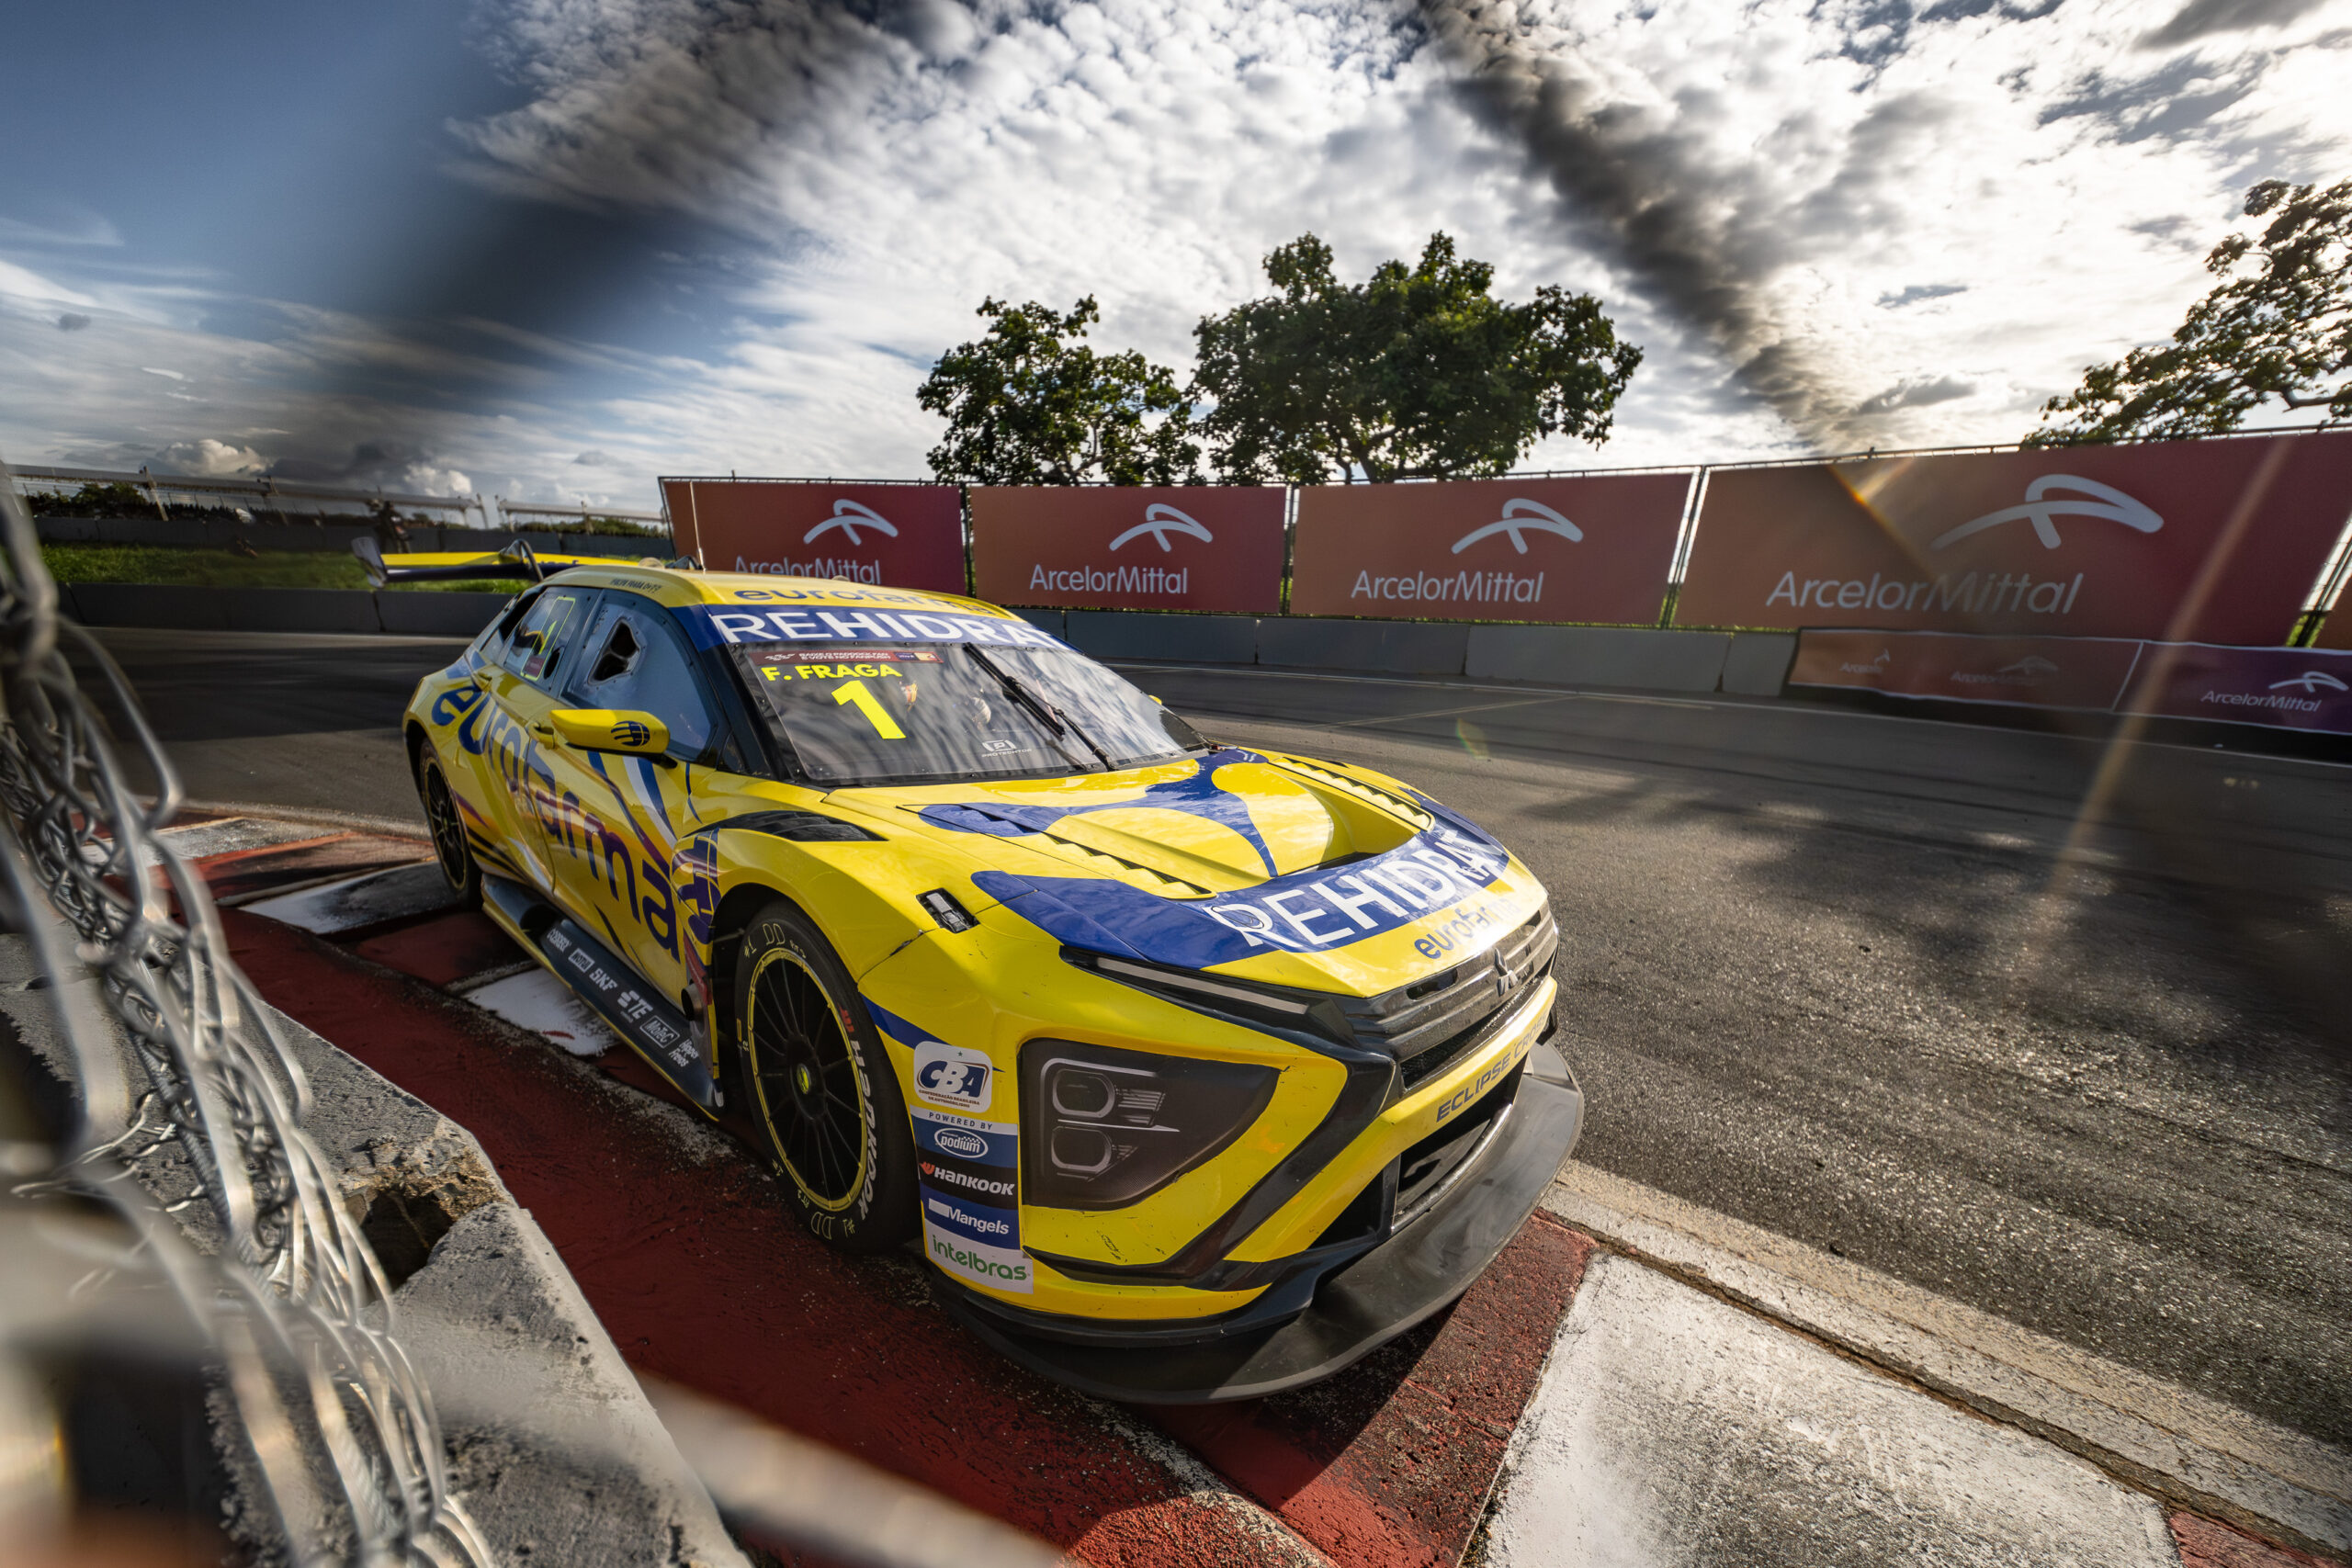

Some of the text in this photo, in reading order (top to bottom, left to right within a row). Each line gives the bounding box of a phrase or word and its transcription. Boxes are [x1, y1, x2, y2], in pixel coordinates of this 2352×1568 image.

[734, 555, 882, 586] ArcelorMittal
[1029, 562, 1188, 595] ArcelorMittal
[1350, 569, 1544, 604] ArcelorMittal
[734, 587, 996, 615] eurofarma
[1765, 570, 2084, 615] ArcelorMittal
[761, 663, 903, 682] F. FRAGA
[831, 680, 907, 740] 1
[2200, 690, 2322, 713] ArcelorMittal
[431, 684, 680, 964] eurofarma
[589, 967, 618, 991] SKF
[920, 1060, 986, 1098] CBA
[1436, 1052, 1511, 1122] ECLIPSE
[929, 1112, 993, 1131] POWERED BY
[940, 1135, 980, 1154] podium
[947, 1205, 1010, 1235] Mangels
[933, 1235, 1028, 1281] intelbras
